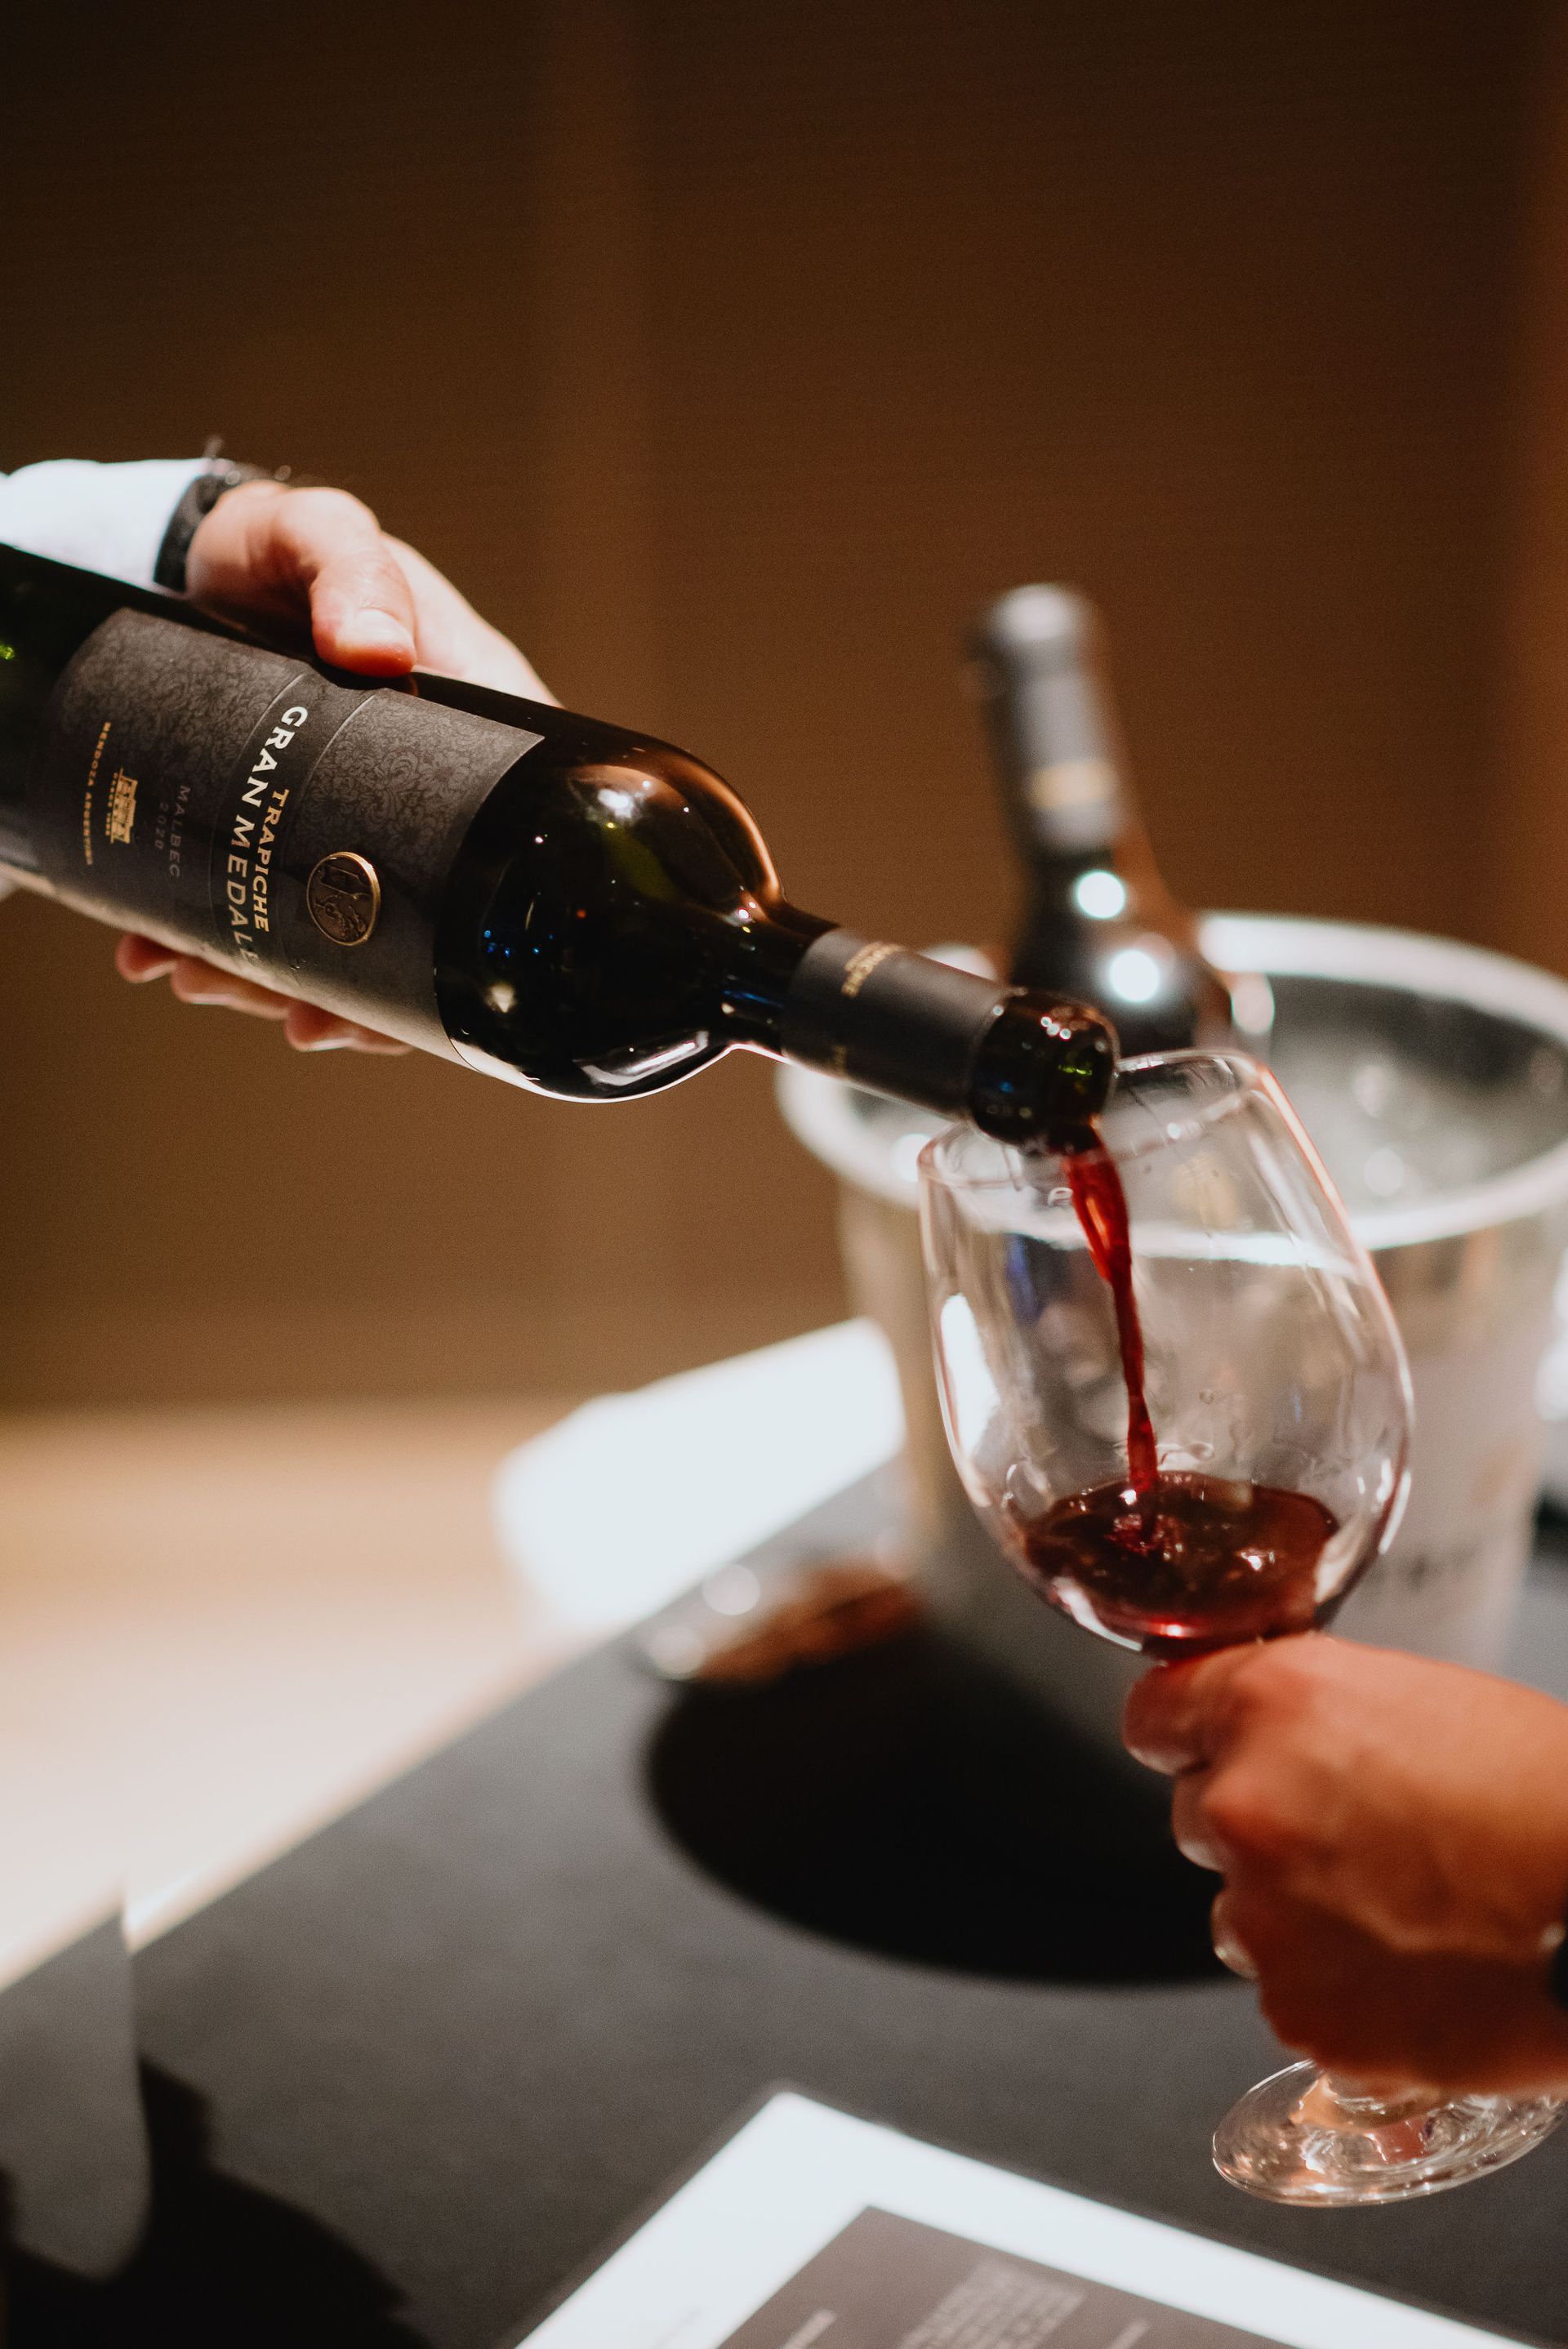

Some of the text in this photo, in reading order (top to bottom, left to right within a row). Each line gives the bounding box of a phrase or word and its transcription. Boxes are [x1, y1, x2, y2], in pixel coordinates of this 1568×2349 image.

[87, 721, 112, 787] MENDOZA
[241, 706, 309, 809] GRAN
[154, 801, 169, 850] 2020
[169, 784, 191, 879] MALBEC
[252, 788, 290, 933] TRAPICHE
